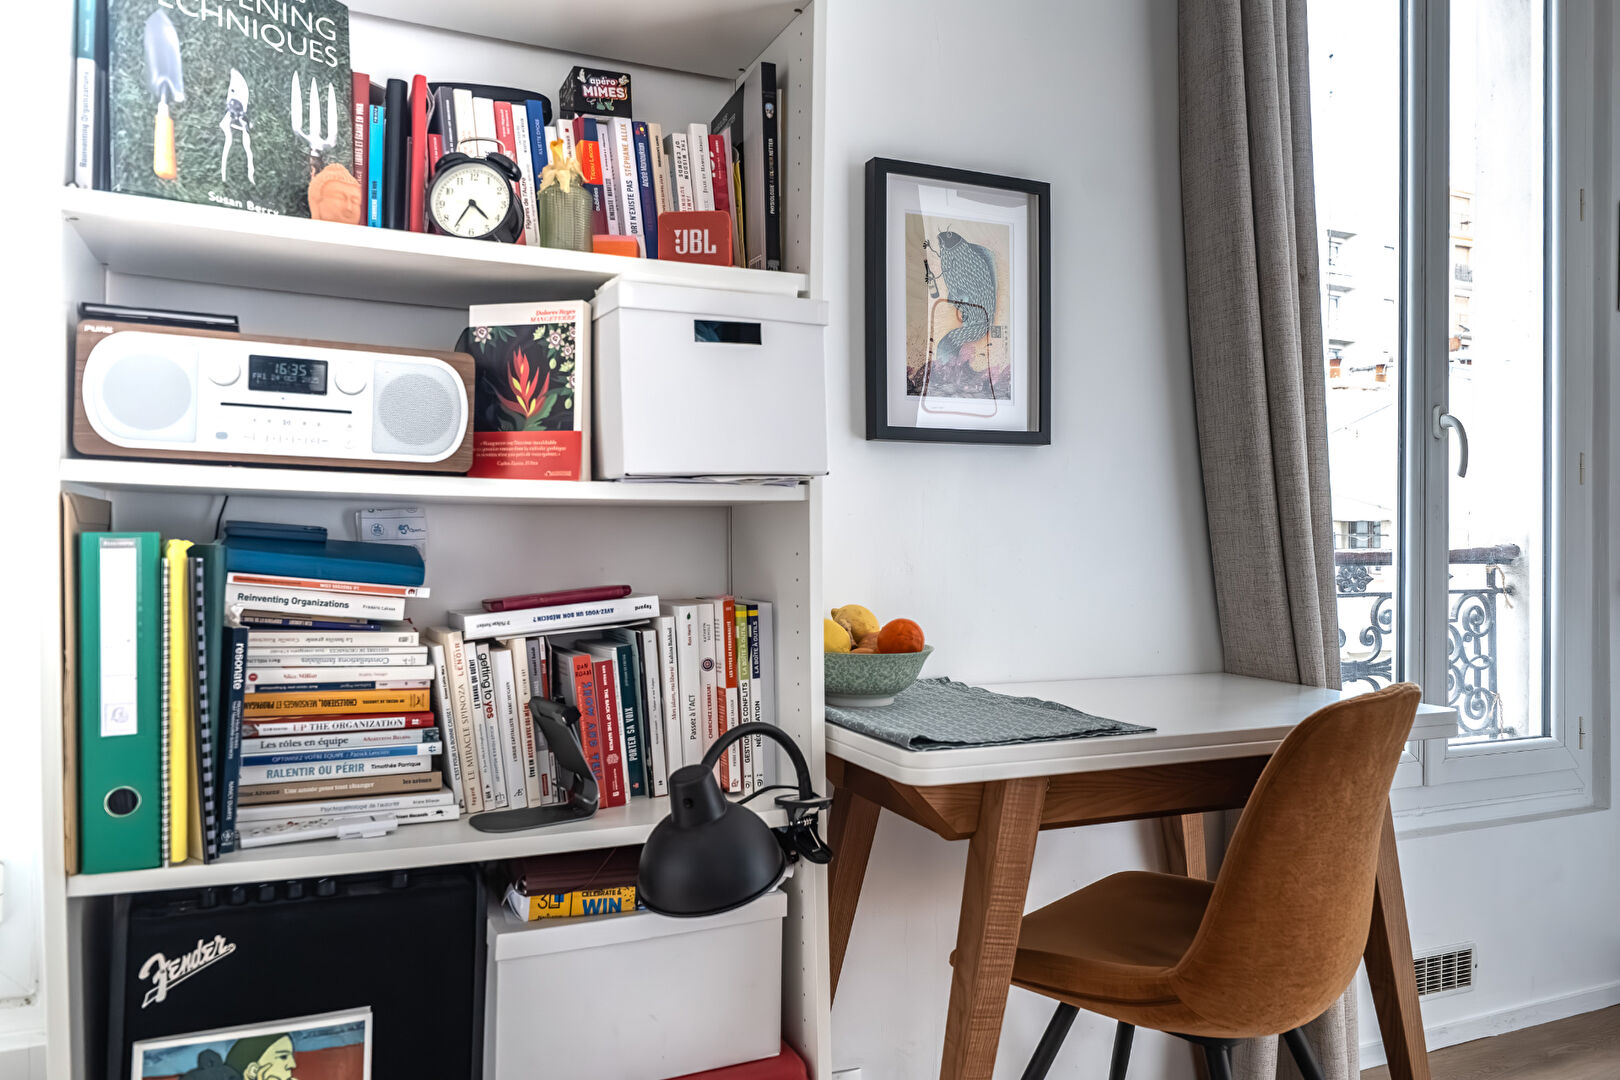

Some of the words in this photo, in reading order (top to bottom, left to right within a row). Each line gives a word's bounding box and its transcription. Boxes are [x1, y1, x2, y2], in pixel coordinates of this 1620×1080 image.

[590, 76, 616, 87] apéro
[583, 86, 625, 98] MIMES
[620, 124, 628, 142] ALLIX
[675, 140, 680, 149] OF
[355, 148, 363, 166] LIBRES
[622, 144, 632, 176] STÉPHANE
[638, 143, 647, 171] Manoukian
[641, 172, 649, 187] André
[207, 191, 242, 209] Susan
[627, 194, 636, 220] N'EXISTE
[676, 229, 716, 255] JBL
[275, 363, 307, 376] 16:35
[237, 593, 289, 606] Reinventing
[291, 596, 349, 610] Organizations
[562, 611, 574, 619] BON
[586, 608, 615, 616] AVEZ-VOUS
[233, 643, 245, 690] resonate
[454, 642, 464, 677] LENOIR
[469, 659, 478, 674] GUÉRIT
[478, 653, 492, 688] getting
[754, 666, 759, 674] LA
[483, 689, 492, 700] to
[670, 683, 675, 692] ma
[245, 701, 274, 710] PROPAGAN
[458, 683, 468, 724] SPINOZA
[582, 682, 594, 716] SHOW
[485, 700, 494, 719] yes
[624, 707, 634, 723] VOIX
[293, 724, 307, 732] UP
[309, 722, 330, 731] THE
[332, 718, 403, 729] ORGANIZATION
[626, 724, 635, 734] SA
[448, 728, 456, 745] BONNE
[586, 722, 596, 747] AND
[260, 741, 276, 749] Les
[279, 737, 302, 748] rôles
[318, 737, 349, 748] équipe
[462, 727, 474, 767] MIRACLE
[526, 739, 534, 758] ACCORD
[627, 736, 638, 761] PORTER
[266, 766, 315, 779] RALENTIR
[319, 765, 332, 776] OU
[336, 763, 365, 774] PÉRIR
[468, 770, 475, 780] LE
[528, 766, 536, 778] ÊTRE
[348, 781, 374, 791] changer
[582, 889, 616, 897] CELEBRATE
[582, 897, 622, 915] WIN
[138, 934, 234, 1002] Fender
